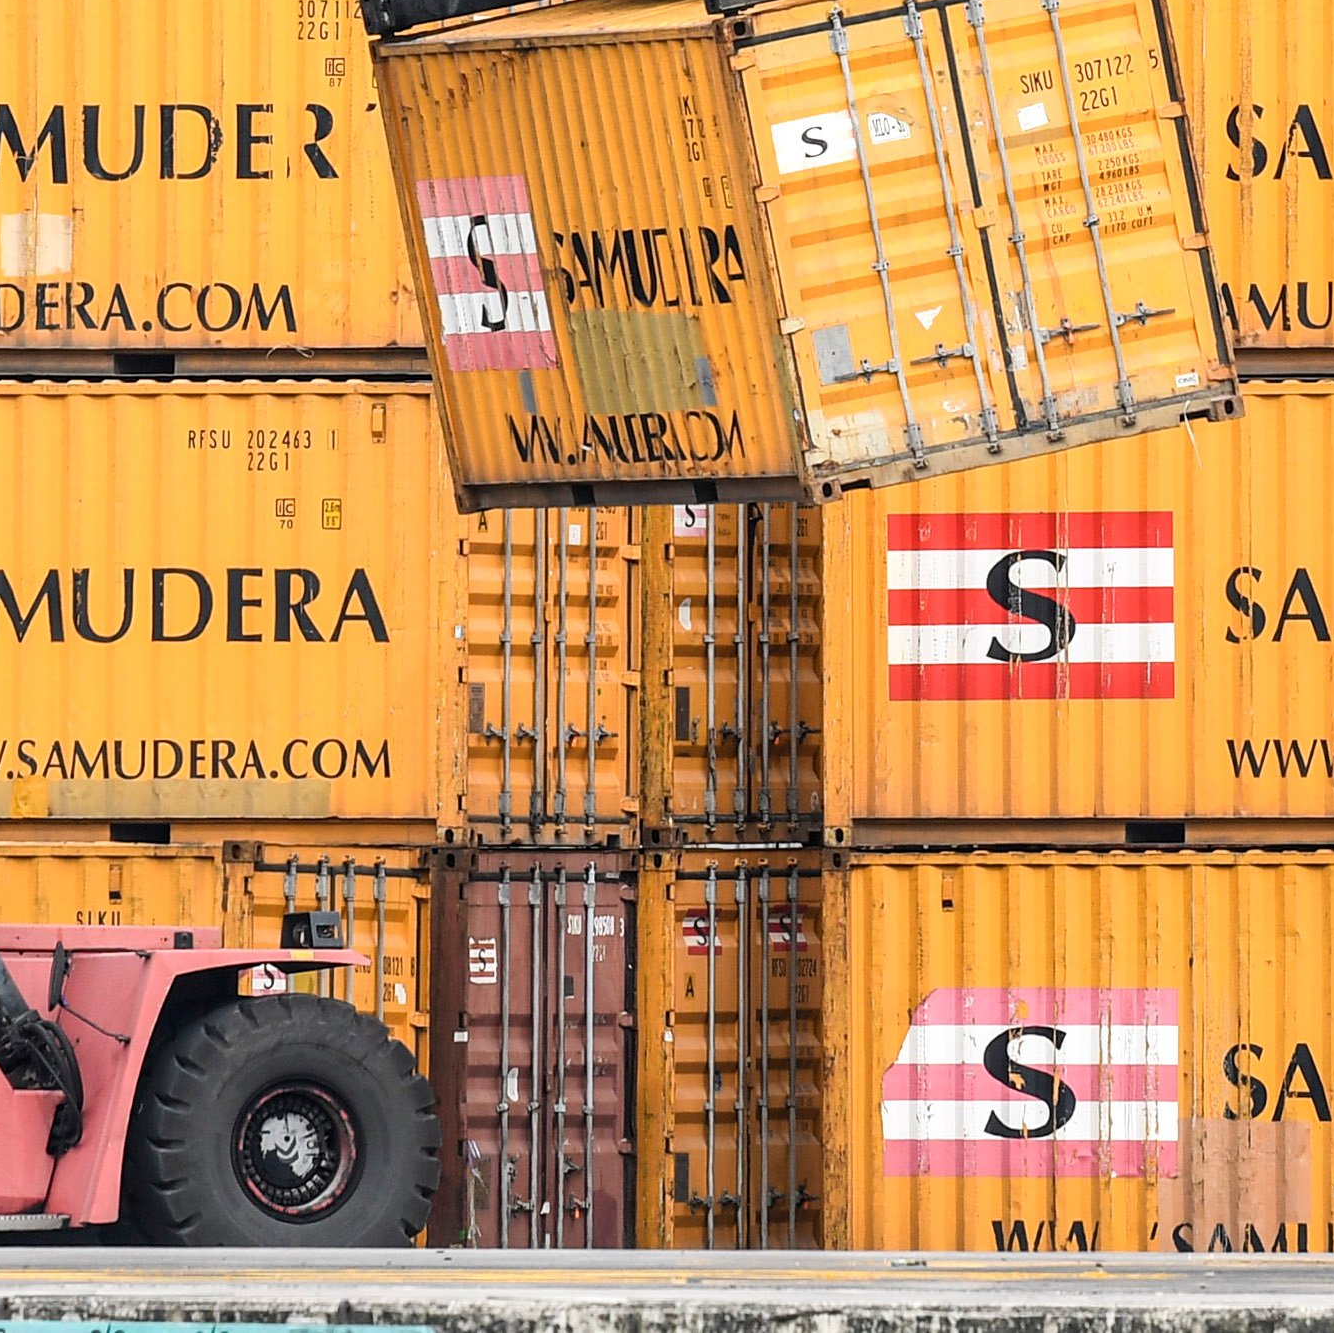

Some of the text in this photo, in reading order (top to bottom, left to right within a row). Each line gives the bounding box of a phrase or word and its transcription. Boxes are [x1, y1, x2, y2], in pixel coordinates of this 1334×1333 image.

[297, 21, 339, 41] 22G1
[329, 78, 342, 88] 87
[1019, 48, 1159, 95] SIKU 307122 5
[1079, 85, 1118, 112] 22G1
[801, 125, 830, 159] S
[1041, 168, 1063, 181] TARE
[187, 429, 232, 449] RFSU
[247, 429, 312, 449] 202463
[247, 451, 289, 471] 22G1
[279, 519, 293, 530] 70
[478, 510, 488, 532] A
[986, 548, 1077, 663] S
[693, 916, 708, 946] S
[477, 948, 489, 973] S
[685, 975, 696, 999] A
[984, 1024, 1077, 1140] S
